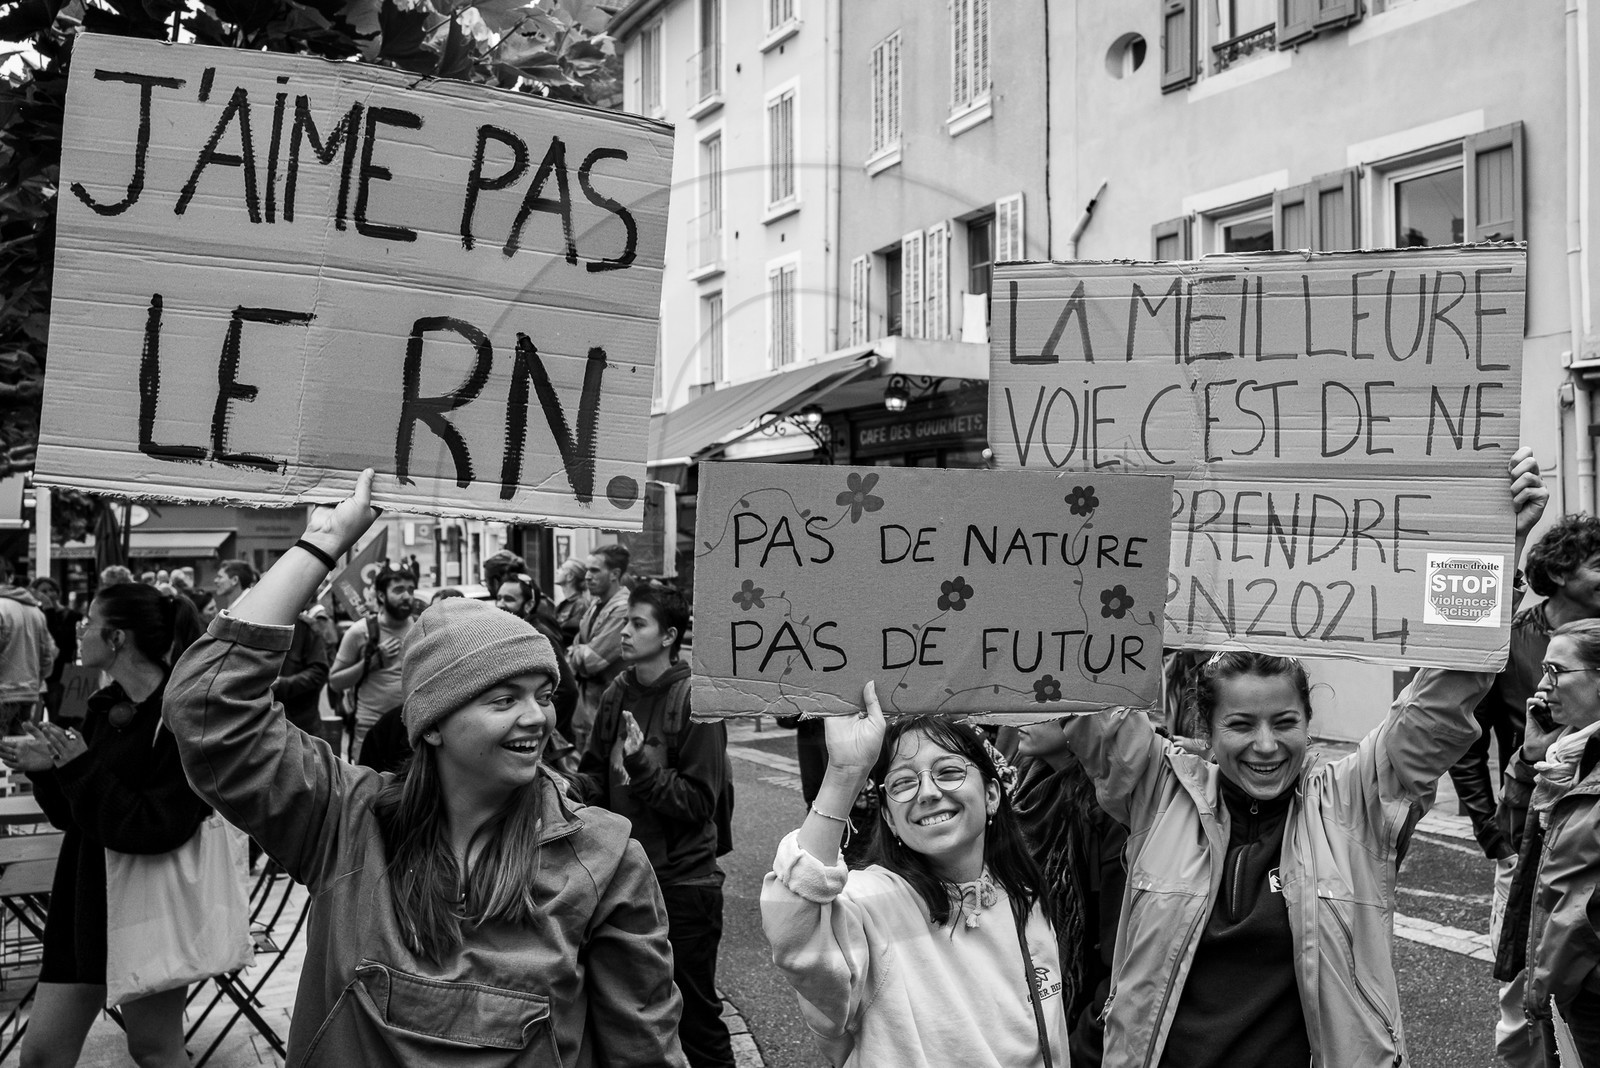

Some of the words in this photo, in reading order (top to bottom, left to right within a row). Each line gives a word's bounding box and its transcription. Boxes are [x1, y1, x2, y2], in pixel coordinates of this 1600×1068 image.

[461, 124, 639, 272] PAS
[1009, 280, 1095, 365] LA
[138, 293, 317, 474] LE
[395, 315, 639, 508] RN.
[890, 422, 911, 442] DES
[916, 413, 984, 438] GOURMETS
[1140, 379, 1299, 465] C'EST
[1321, 381, 1396, 459] DE
[1425, 382, 1505, 457] NE
[733, 512, 835, 568] PAS
[880, 524, 937, 564] DE
[963, 524, 1148, 568] NATURE
[1470, 562, 1499, 571] droite
[1431, 574, 1497, 594] STOP
[1431, 594, 1497, 608] violences
[1435, 606, 1491, 618] racisme
[731, 620, 848, 676] PAS
[881, 627, 946, 670] DE
[981, 628, 1147, 674] FUTUR
